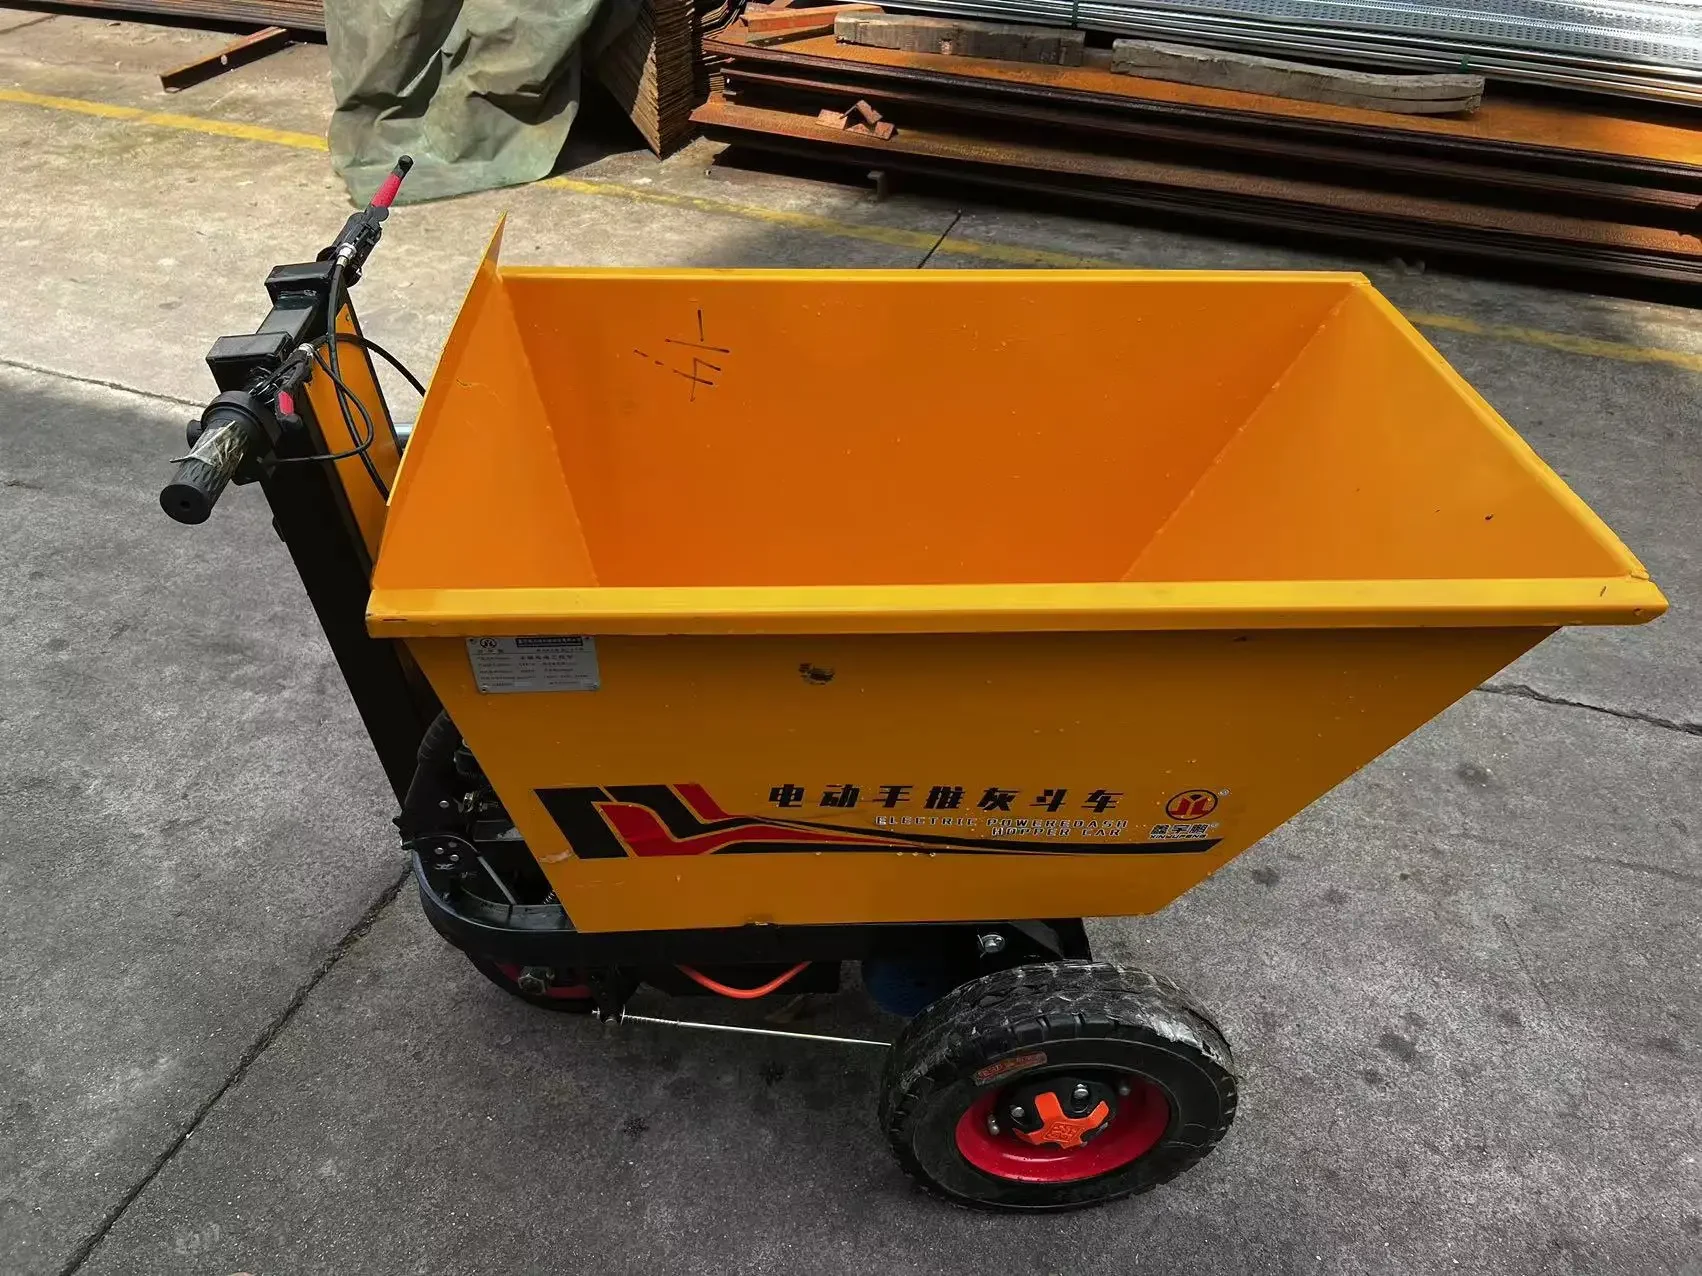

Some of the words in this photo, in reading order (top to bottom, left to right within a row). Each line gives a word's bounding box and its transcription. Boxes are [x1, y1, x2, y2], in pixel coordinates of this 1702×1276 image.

[769, 783, 1124, 813] 电动手推灰斗车
[875, 816, 977, 827] ELECTRIC
[991, 827, 1070, 836] HOPPER
[1081, 828, 1121, 836] CAR
